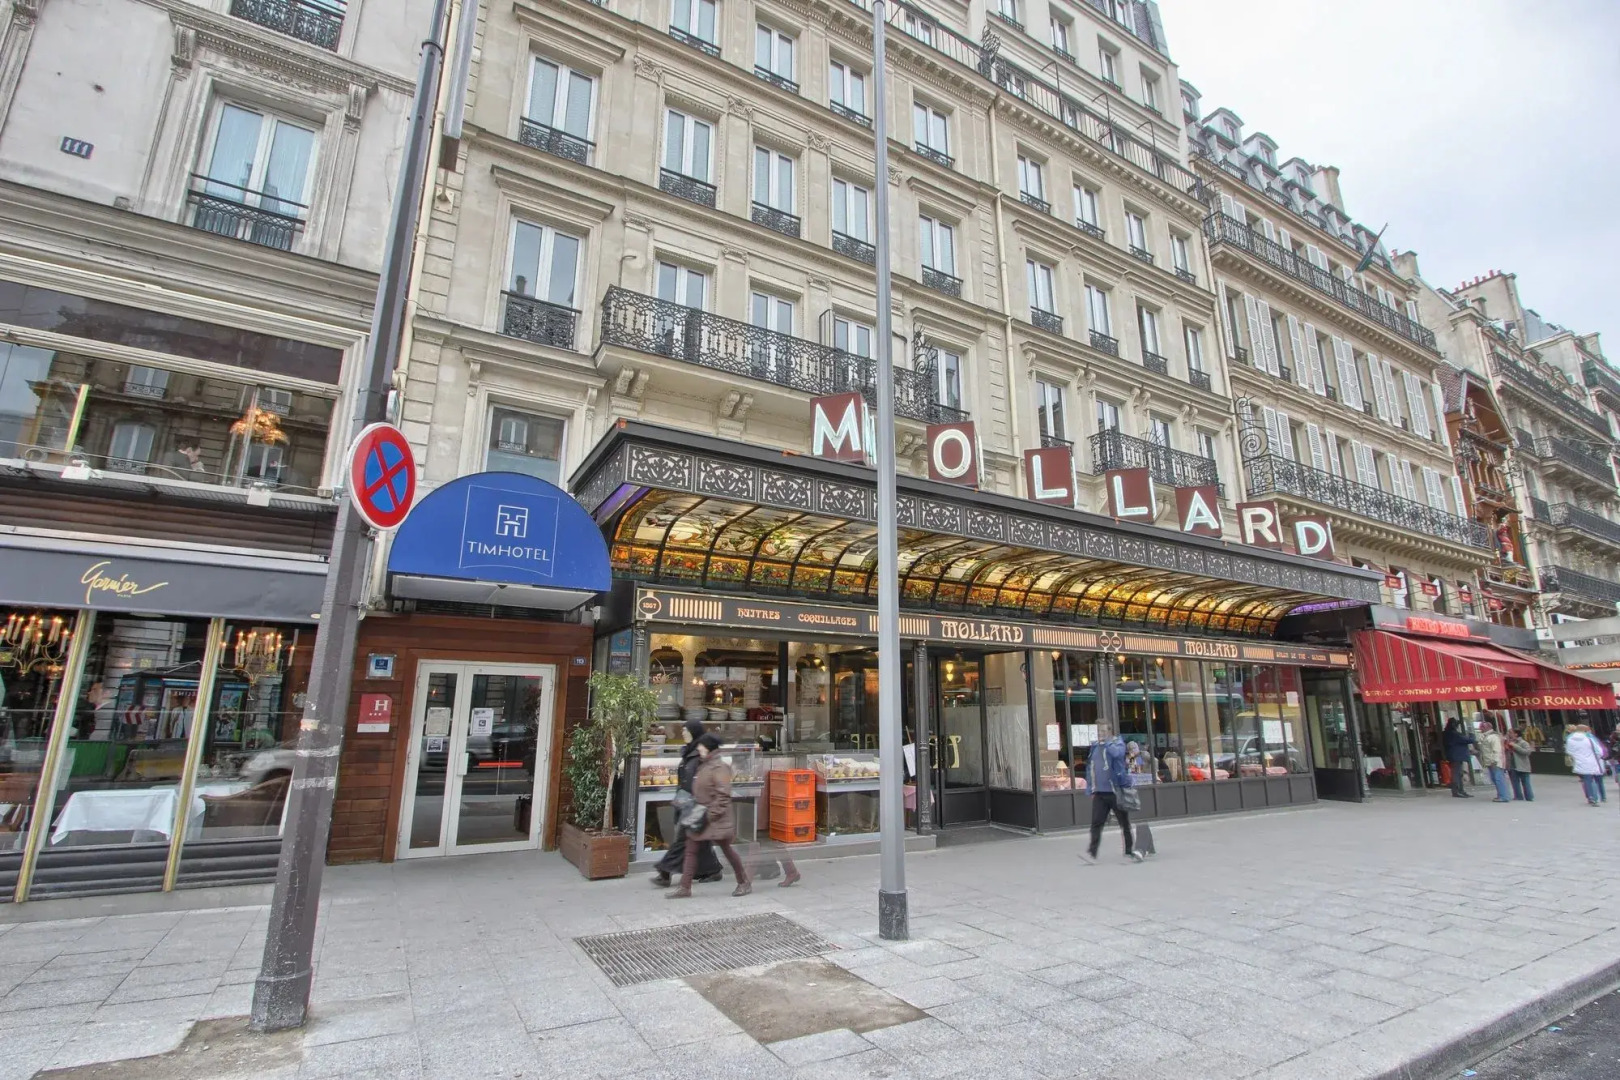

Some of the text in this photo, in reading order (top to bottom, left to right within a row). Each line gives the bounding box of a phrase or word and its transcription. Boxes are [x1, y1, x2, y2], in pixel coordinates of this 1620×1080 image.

[64, 139, 89, 157] 111
[466, 540, 551, 562] TIMHOTEL
[81, 561, 169, 605] Garnier
[737, 608, 781, 621] HUITRES
[797, 613, 857, 627] COQUILLAGES
[941, 620, 1024, 643] MOLLARD
[1184, 640, 1239, 658] MOLLARD
[1364, 689, 1395, 697] SERVICE
[1398, 688, 1432, 696] CONTINU
[1455, 686, 1474, 694] NON
[1475, 684, 1498, 693] STOP
[374, 699, 389, 711] H
[1543, 695, 1604, 706] ROMAIN
